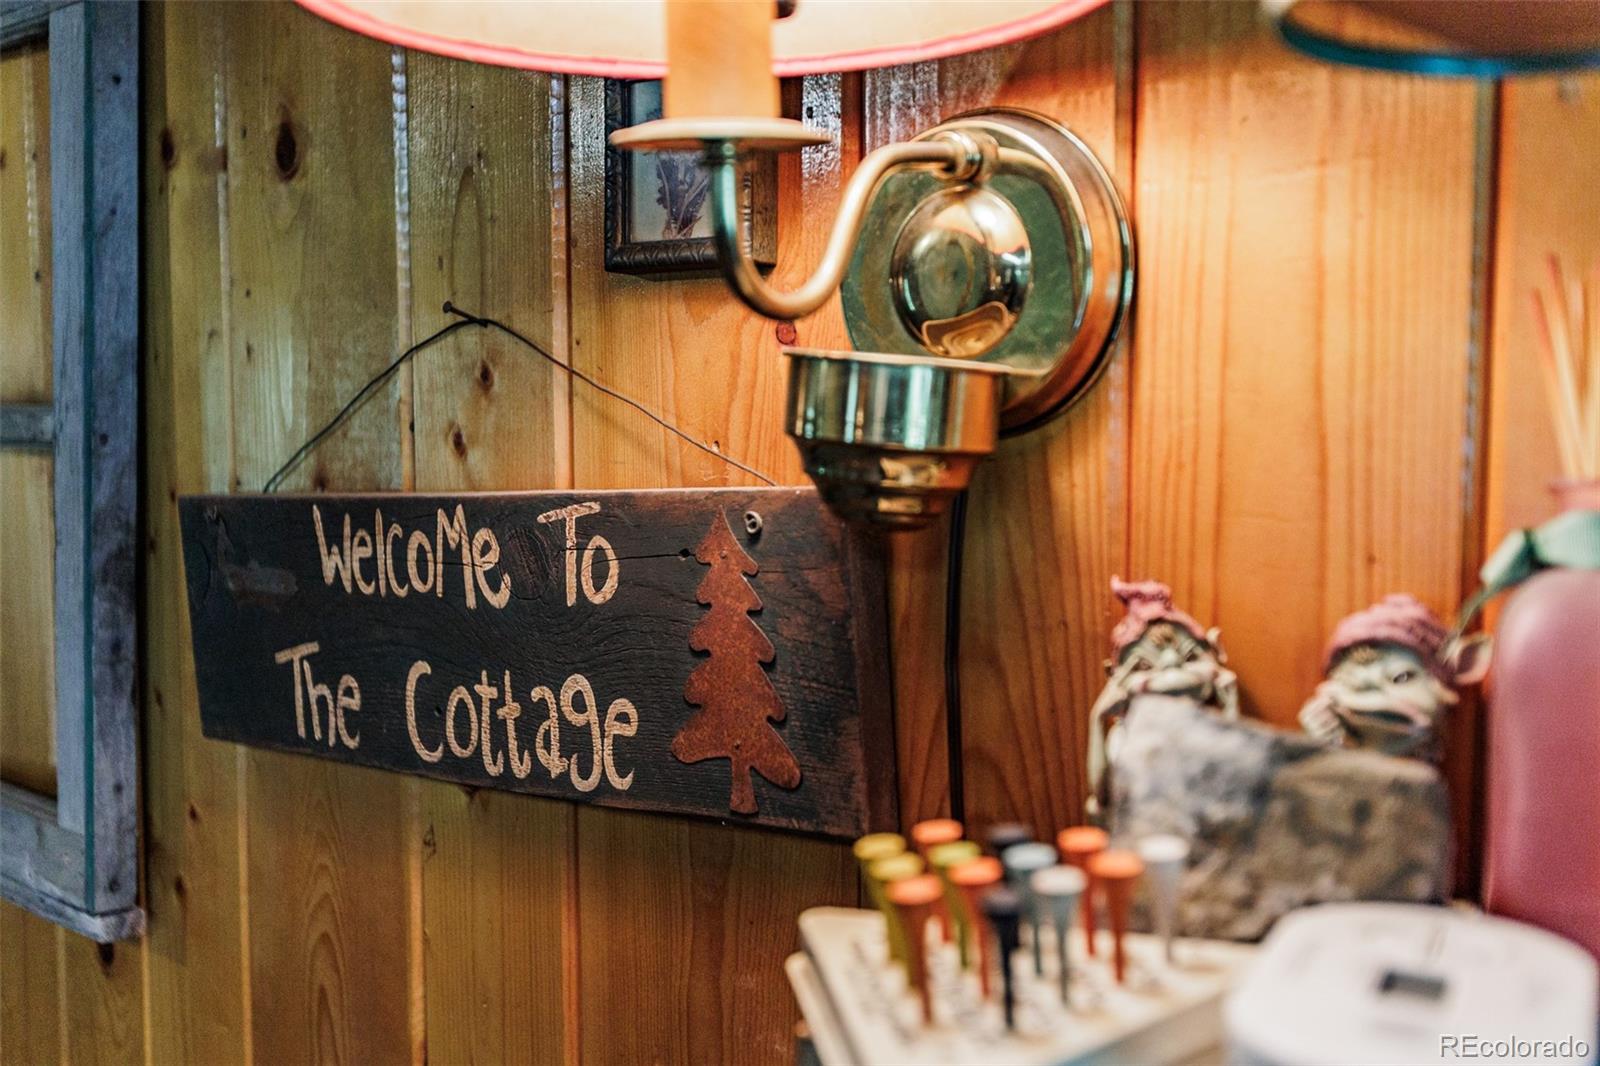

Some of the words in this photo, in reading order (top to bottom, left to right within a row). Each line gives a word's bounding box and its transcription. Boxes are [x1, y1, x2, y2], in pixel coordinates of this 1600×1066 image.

[537, 501, 619, 608] To
[274, 641, 362, 750] The
[405, 660, 639, 793] Cottage
